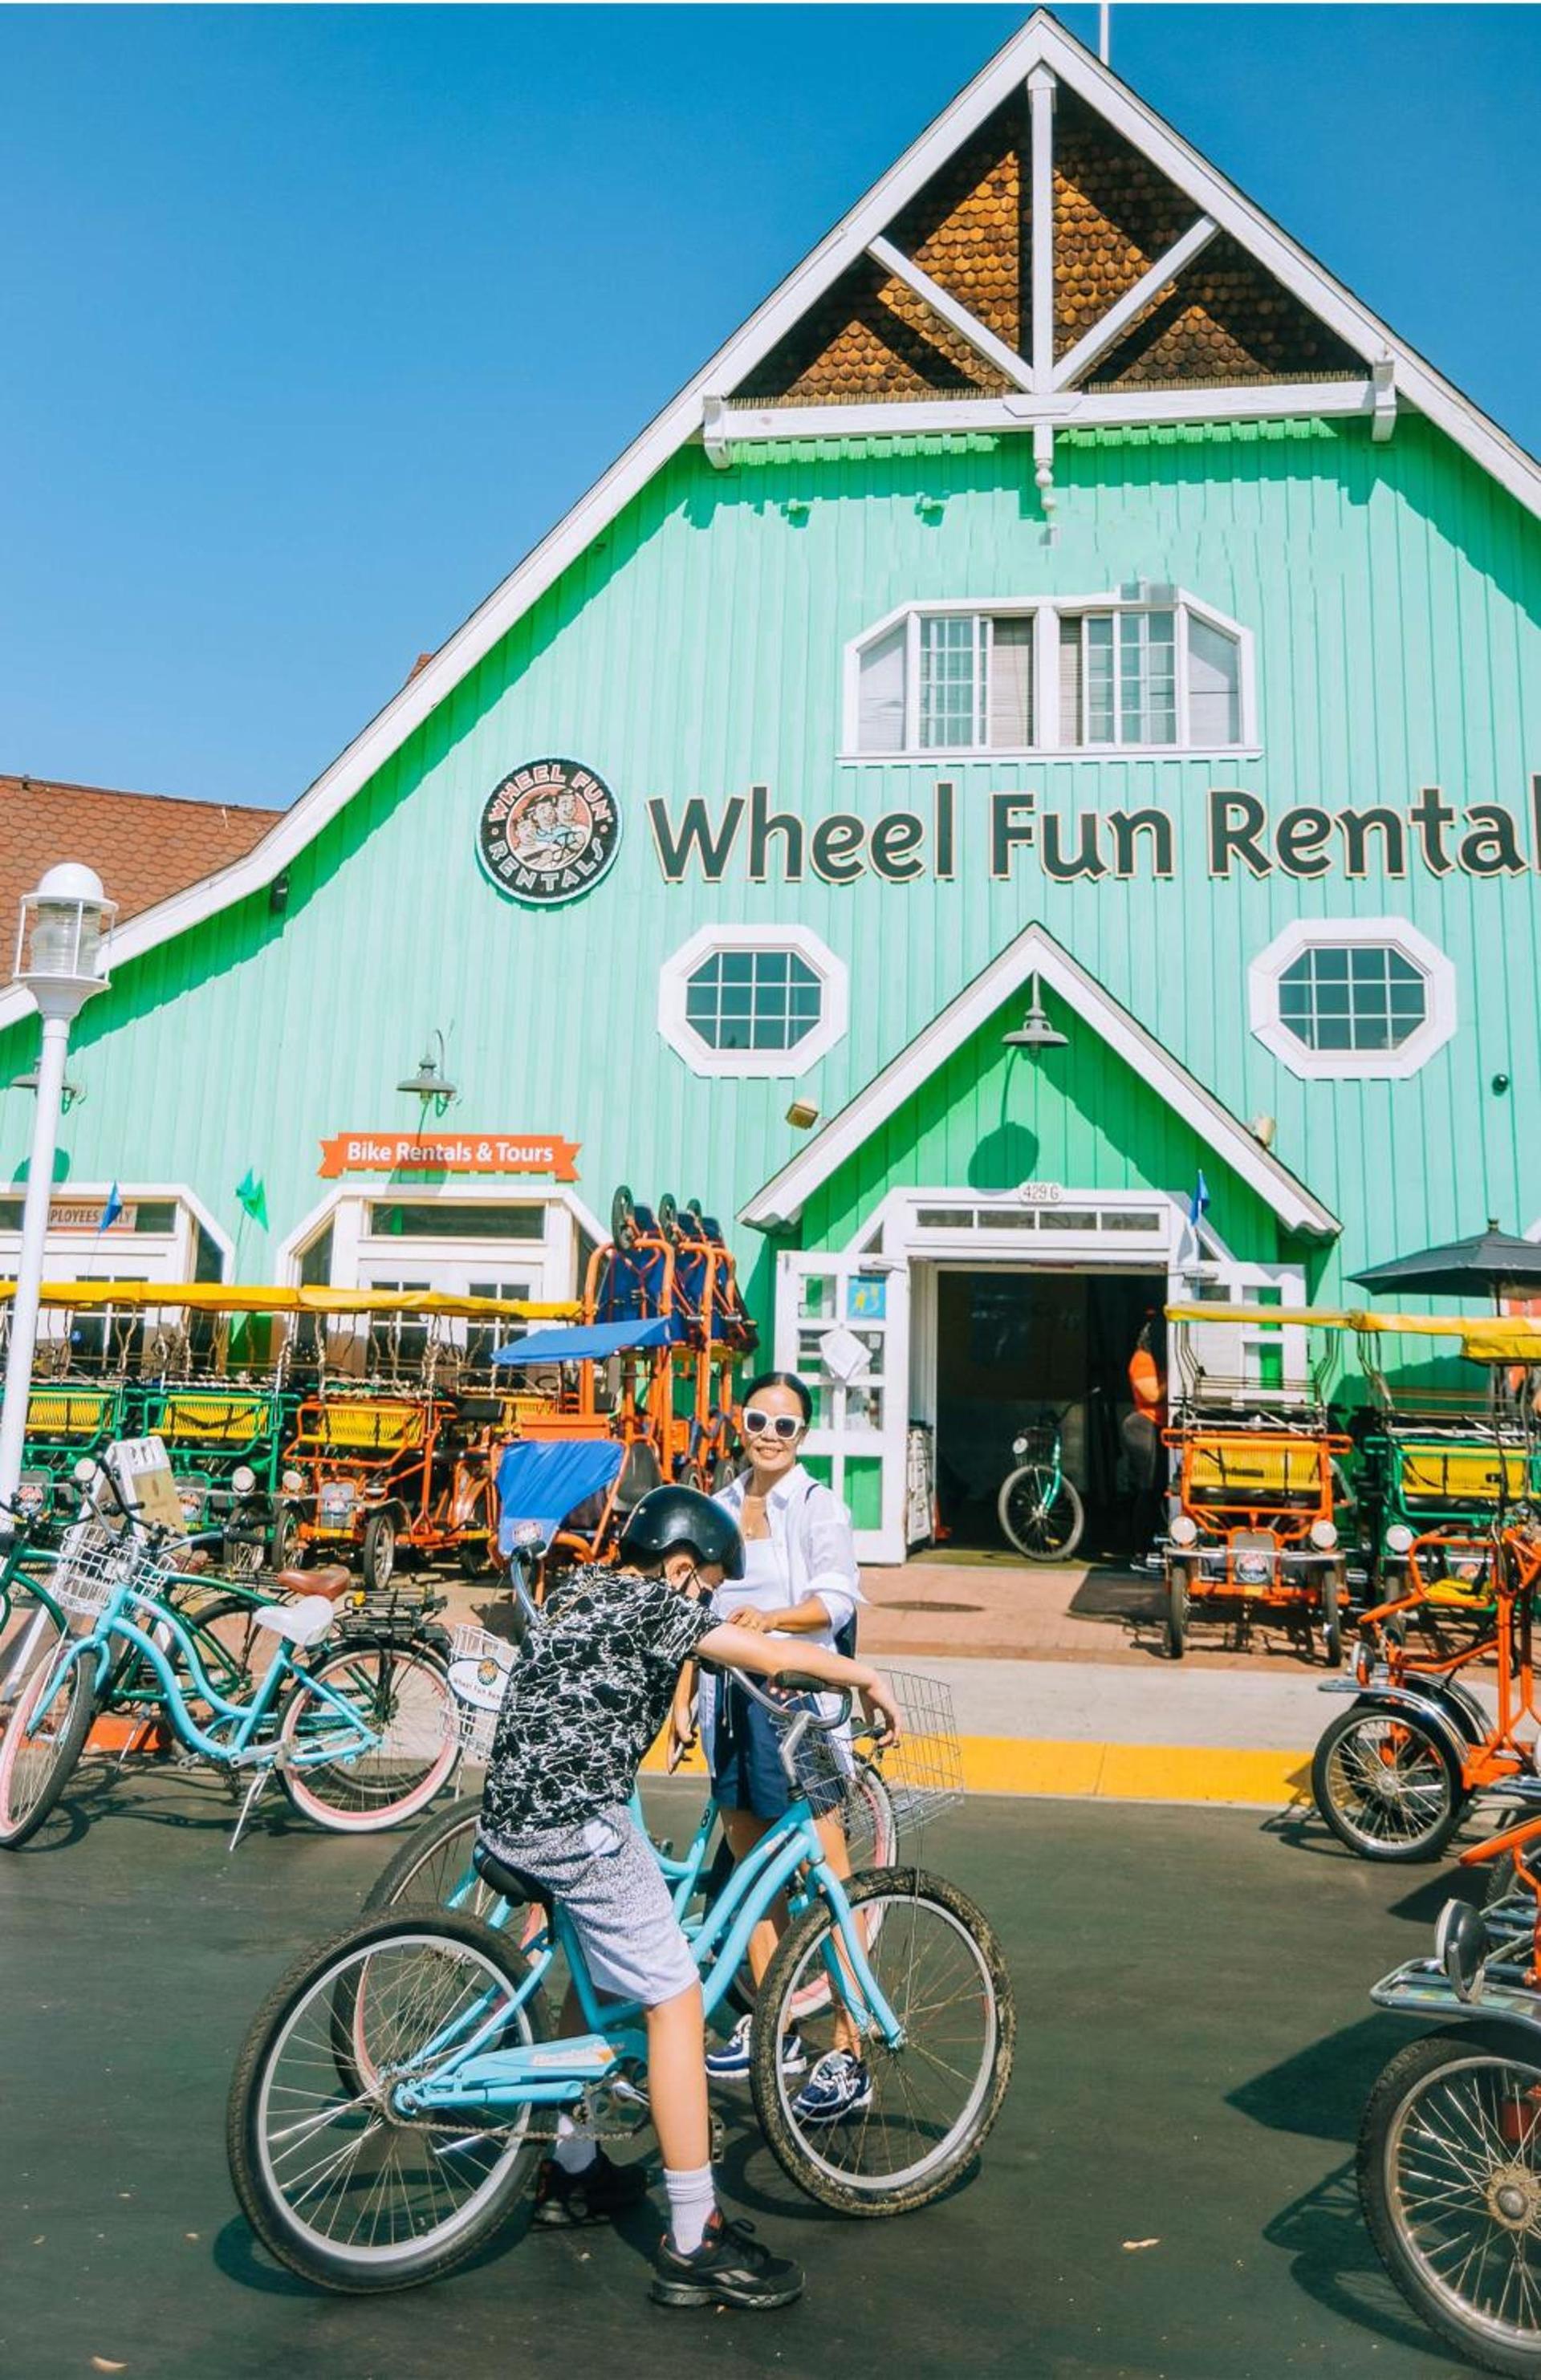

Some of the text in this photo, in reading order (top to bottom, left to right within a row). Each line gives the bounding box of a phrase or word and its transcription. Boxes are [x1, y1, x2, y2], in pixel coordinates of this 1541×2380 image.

[488, 764, 612, 822] WHEEL FUN
[647, 782, 955, 882] Wheel
[990, 790, 1174, 882] Fun
[489, 837, 604, 891] RENTALS
[347, 1141, 554, 1162] Bike Rentals & Tours
[49, 1208, 100, 1223] PLOYEES
[701, 1808, 710, 1829] 8
